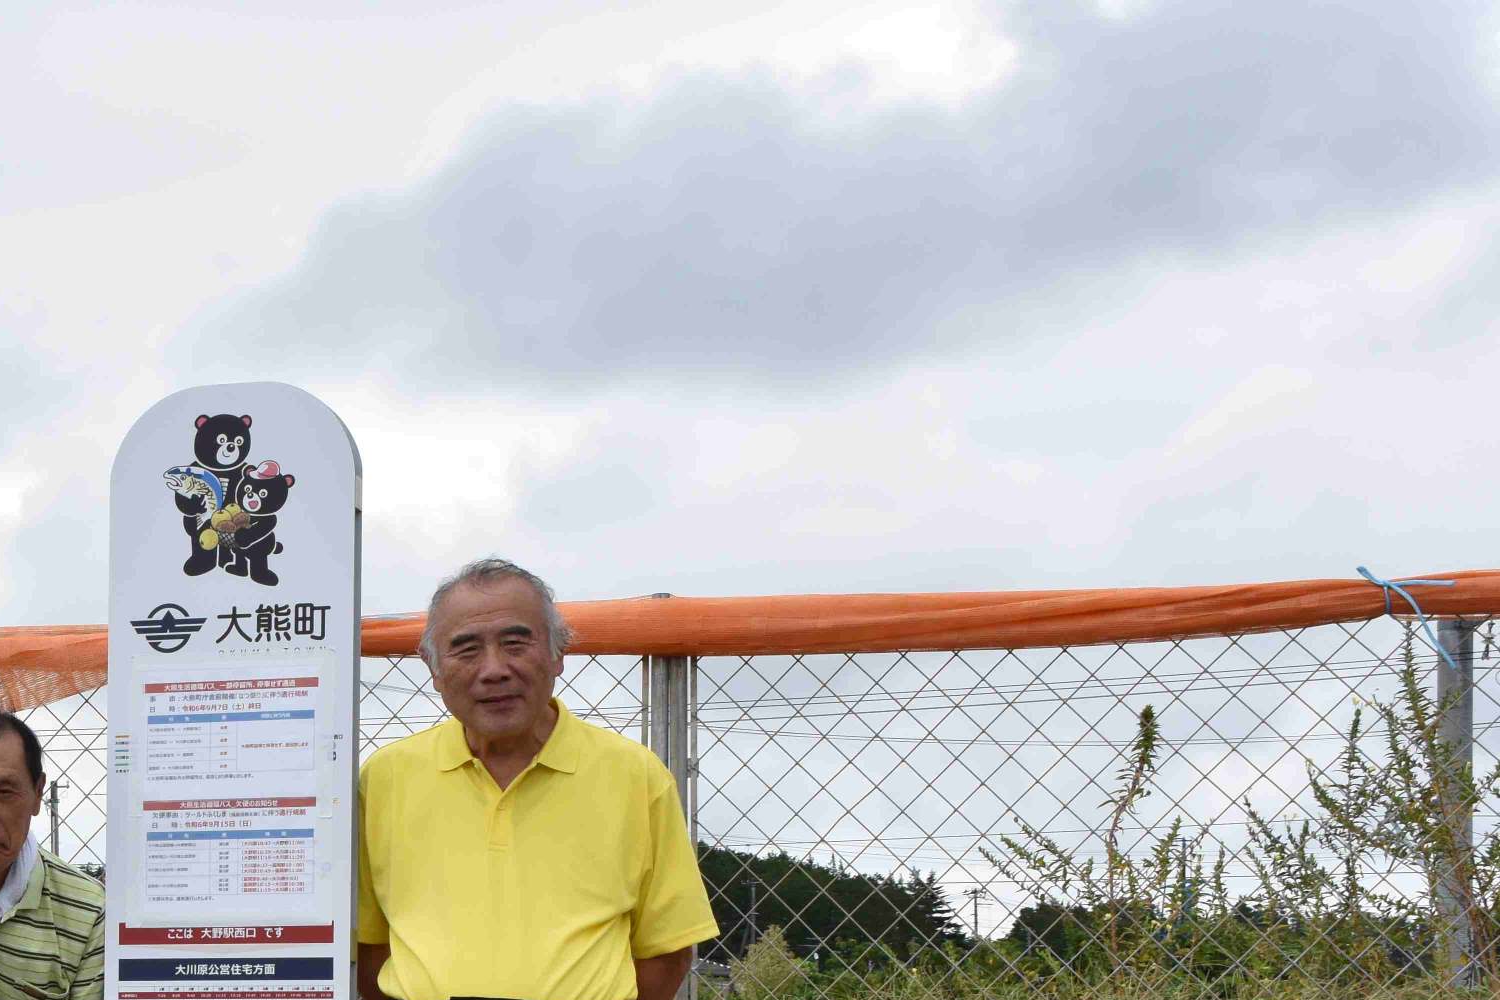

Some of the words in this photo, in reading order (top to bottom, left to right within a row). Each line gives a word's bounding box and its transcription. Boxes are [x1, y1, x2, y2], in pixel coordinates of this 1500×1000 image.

[215, 602, 331, 644] 大熊町
[167, 928, 193, 939] ここは
[200, 926, 257, 939] 大野駅西口
[264, 926, 284, 938] です
[174, 963, 276, 976] 大川原公営住宅方面
